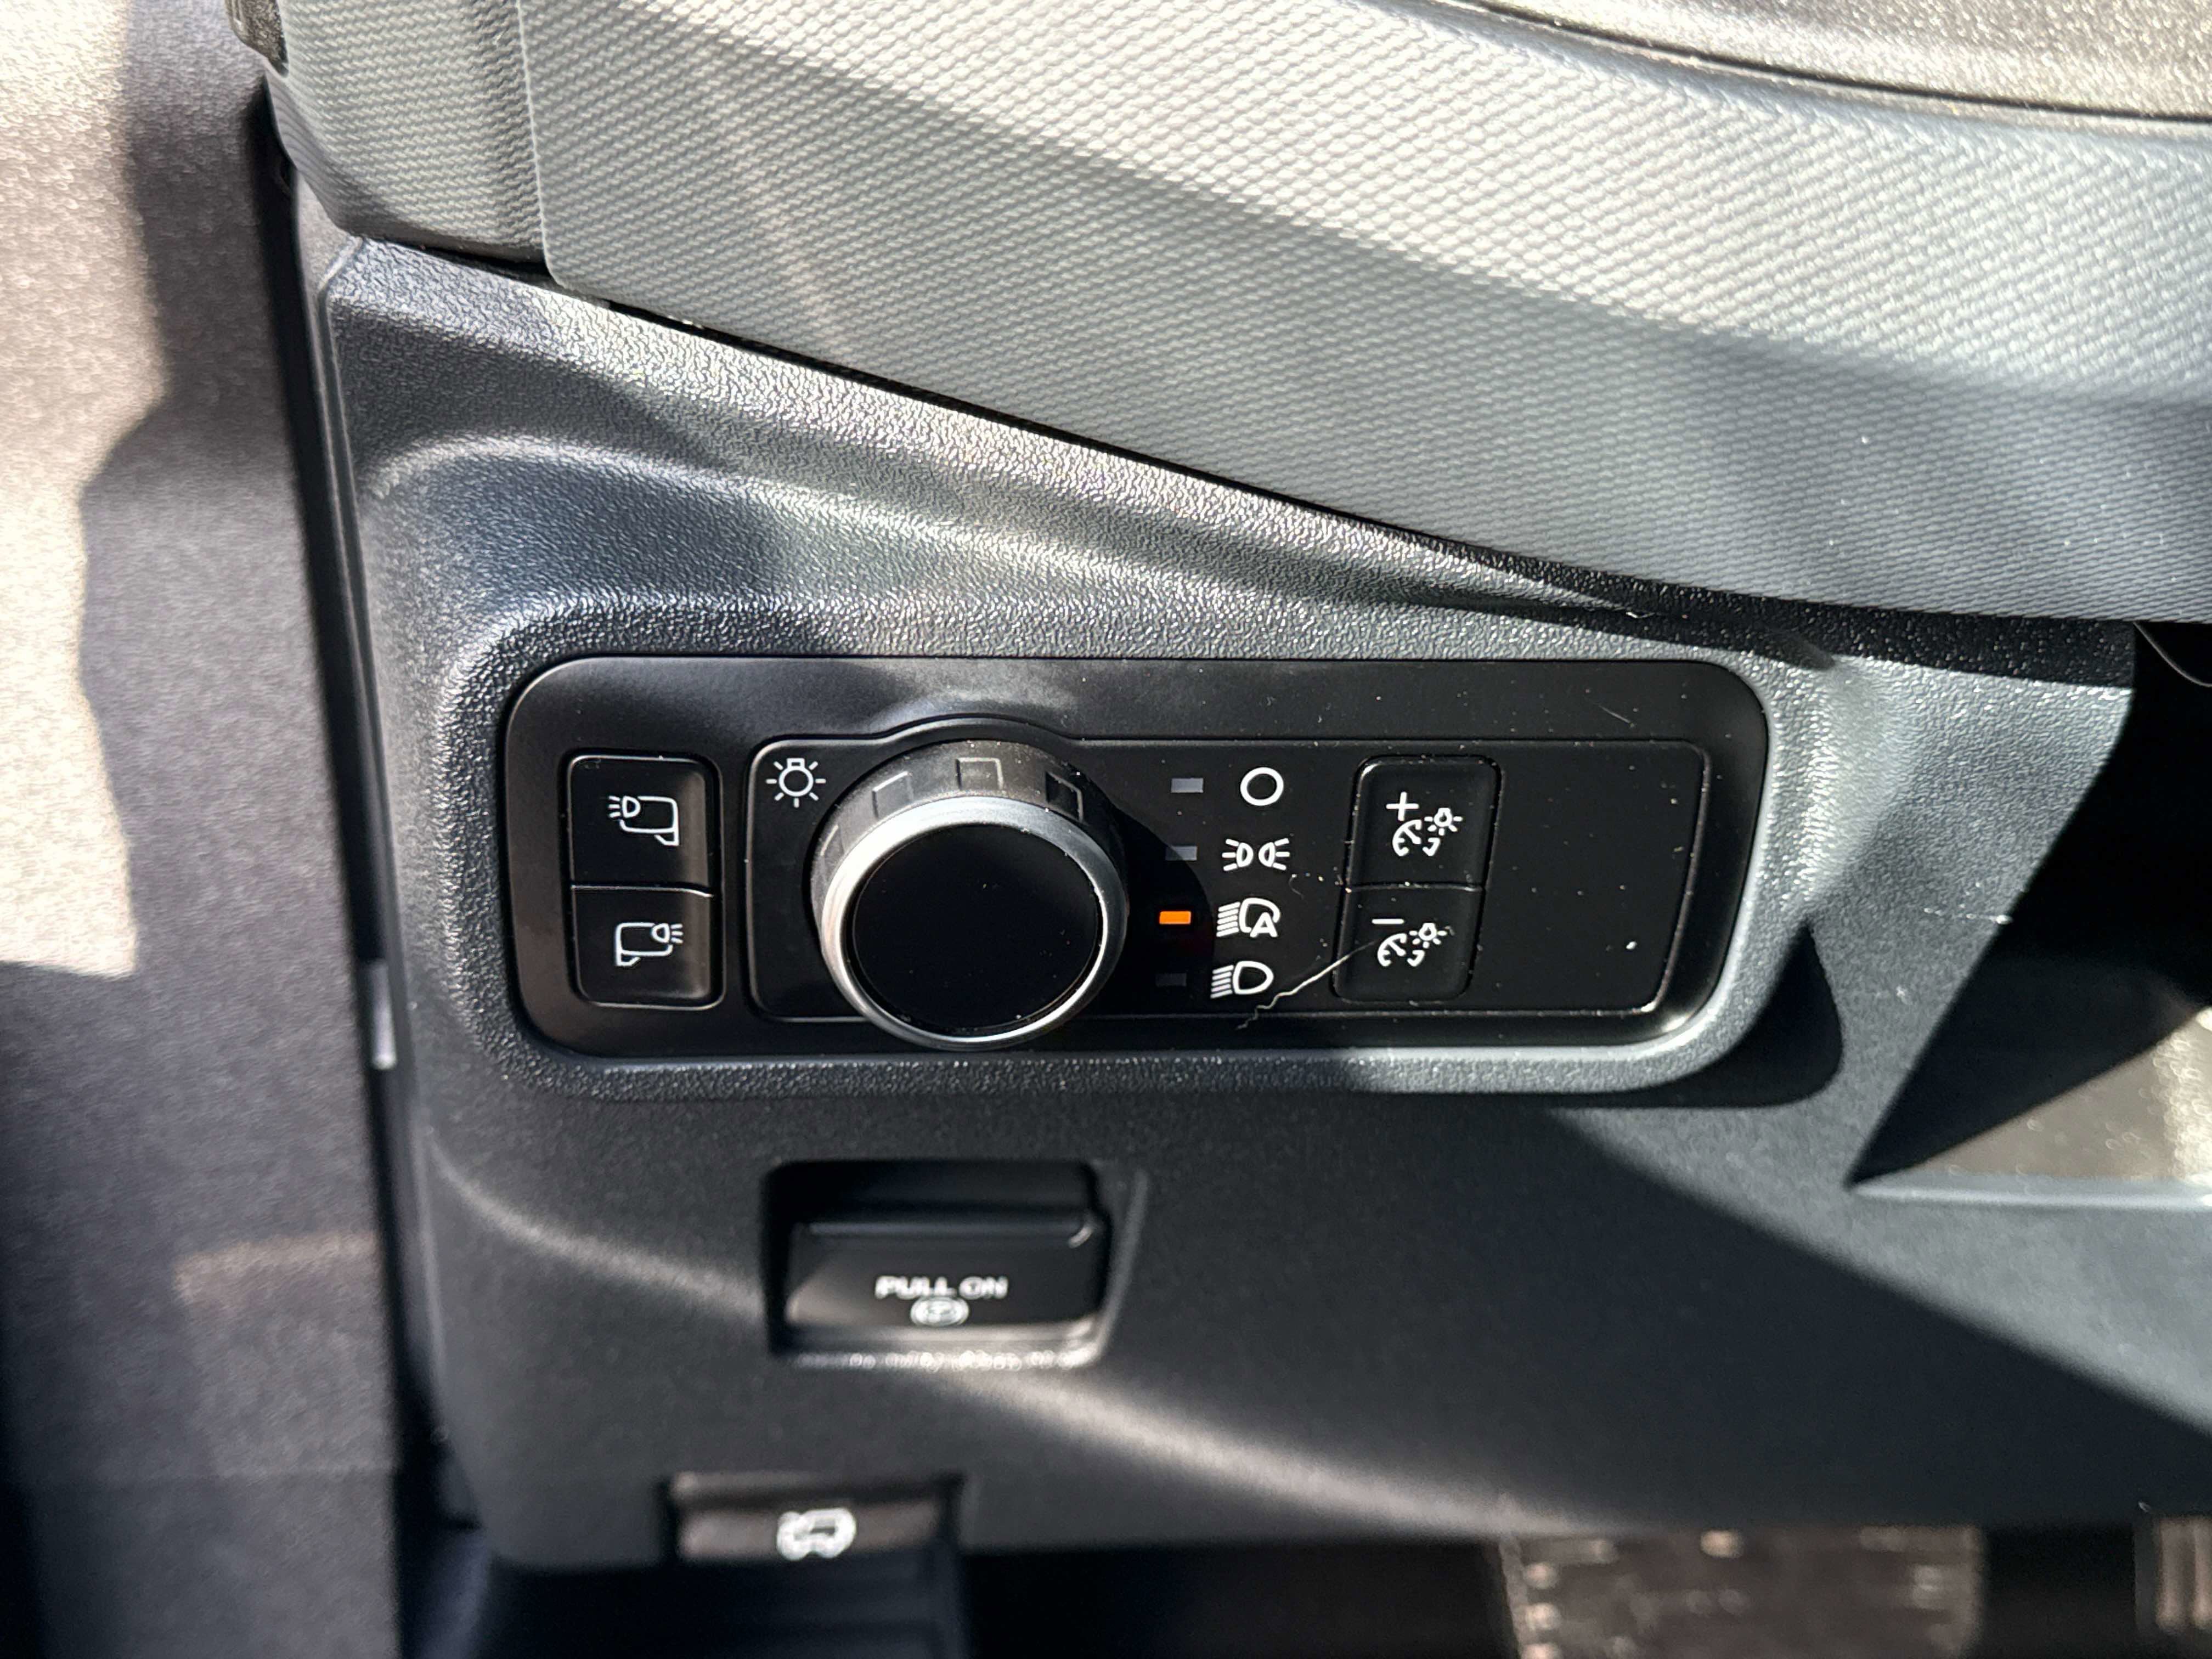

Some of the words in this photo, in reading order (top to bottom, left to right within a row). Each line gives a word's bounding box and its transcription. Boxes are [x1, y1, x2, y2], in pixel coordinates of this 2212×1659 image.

[1250, 912, 1278, 938] A
[875, 1276, 957, 1300] PULL
[959, 1276, 1008, 1300] ON
